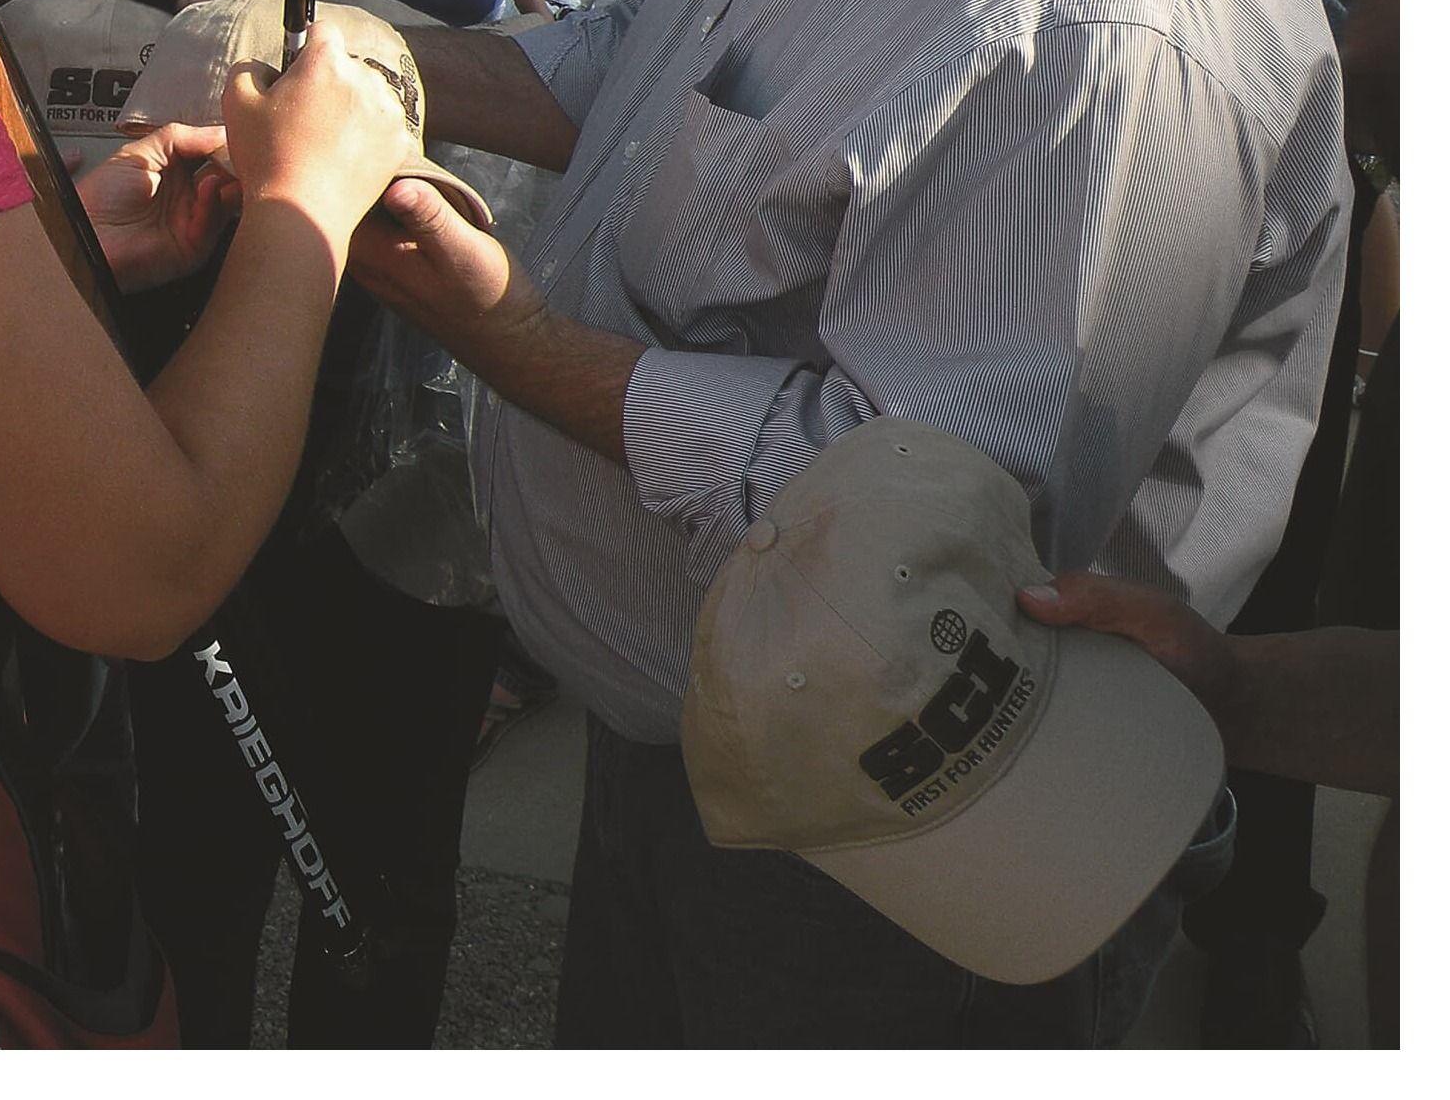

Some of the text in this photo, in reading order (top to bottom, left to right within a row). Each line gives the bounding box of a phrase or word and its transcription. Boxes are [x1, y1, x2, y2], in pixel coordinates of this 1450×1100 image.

[47, 67, 142, 109] SC
[47, 108, 77, 121] FIRST
[80, 108, 105, 122] FOR
[193, 639, 351, 929] KRIEGHOFF
[859, 628, 1020, 802] SCI
[901, 673, 1037, 817] FIRST FOR HUNTERS
